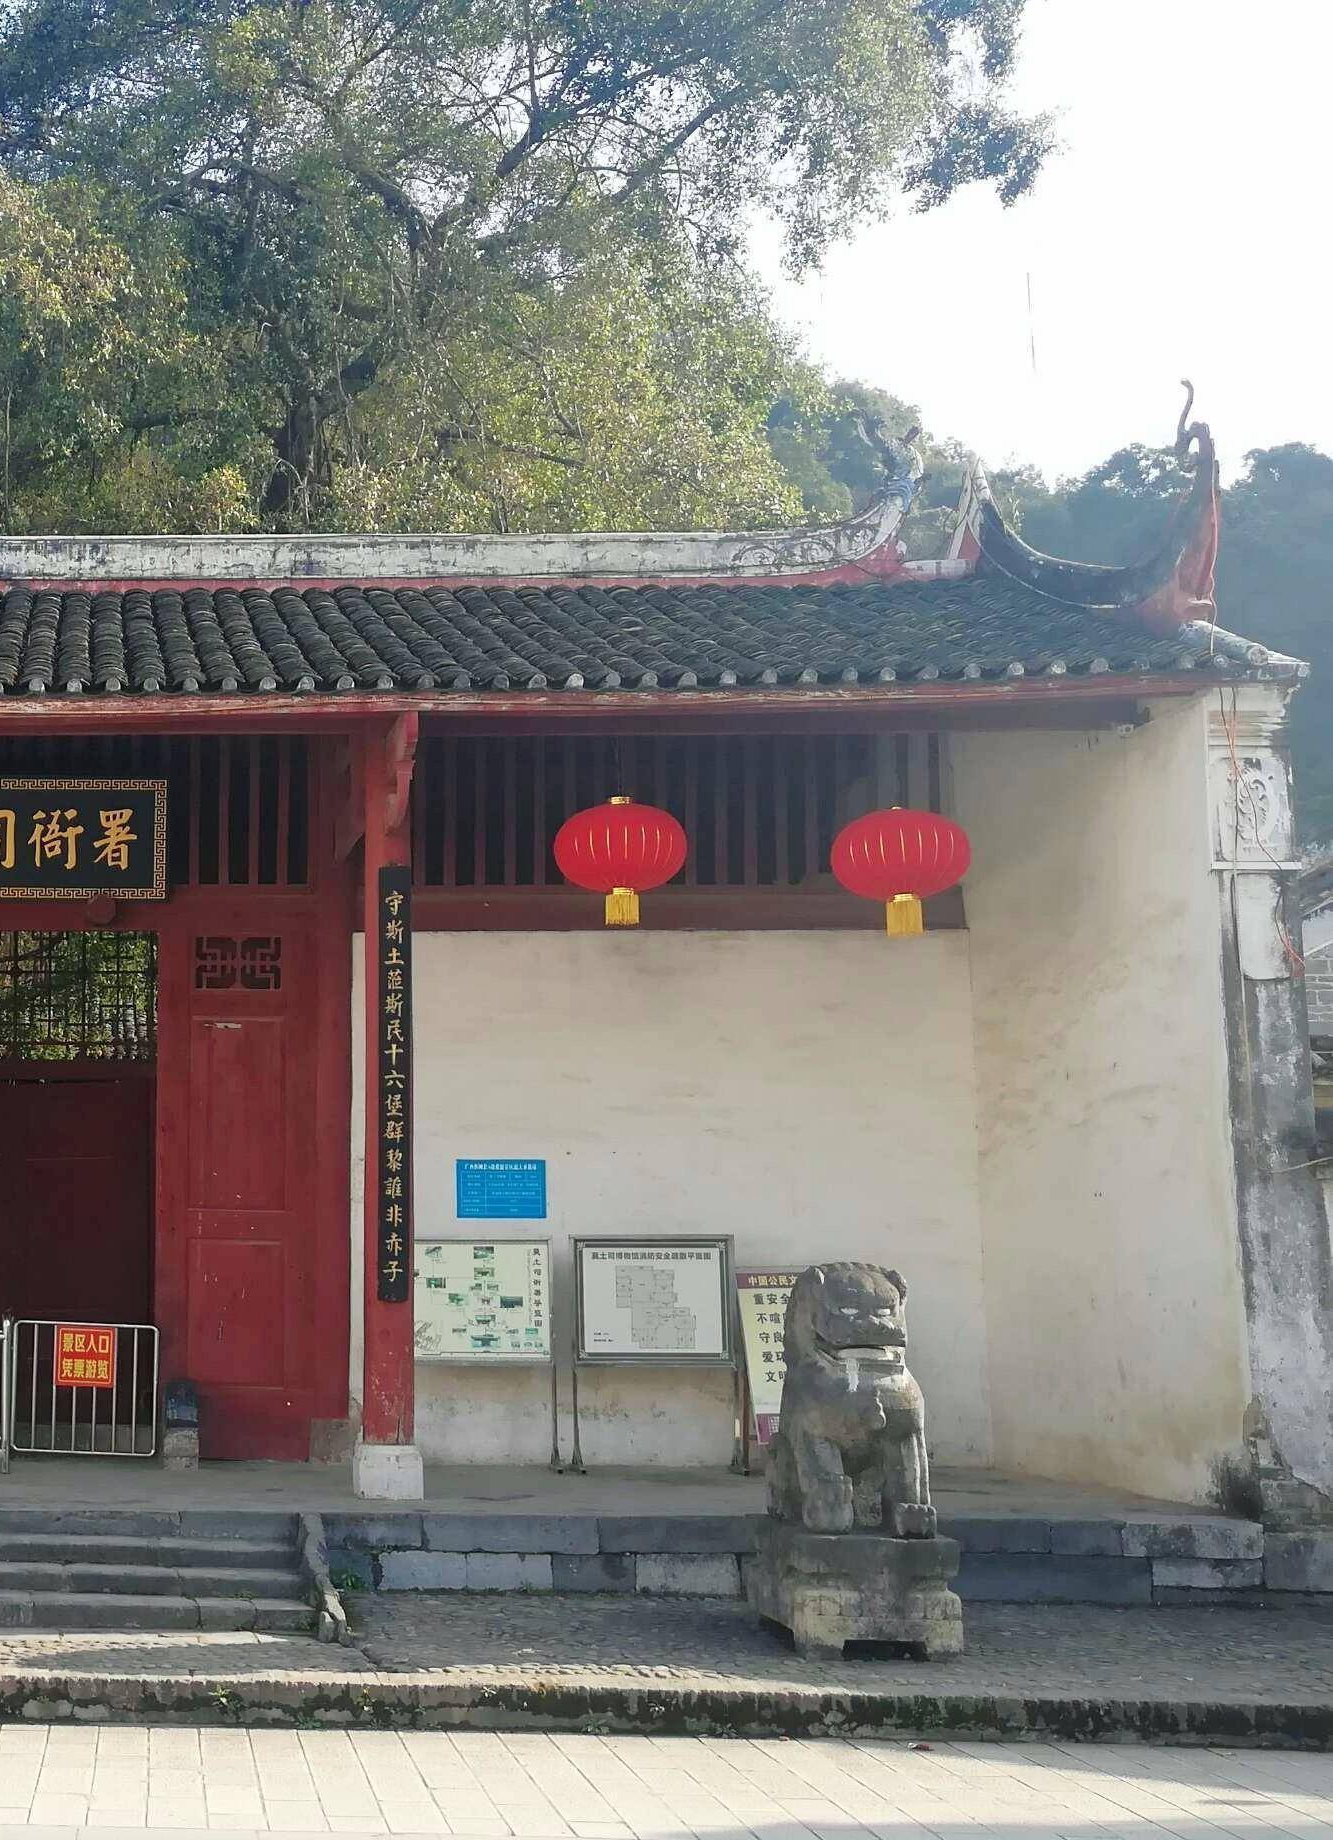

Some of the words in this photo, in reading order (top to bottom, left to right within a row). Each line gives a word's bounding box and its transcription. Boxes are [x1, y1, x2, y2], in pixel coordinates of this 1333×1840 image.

[756, 1312, 786, 1323] 不喧
[62, 1333, 109, 1354] 景区入口
[62, 1358, 109, 1379] 凭票游览
